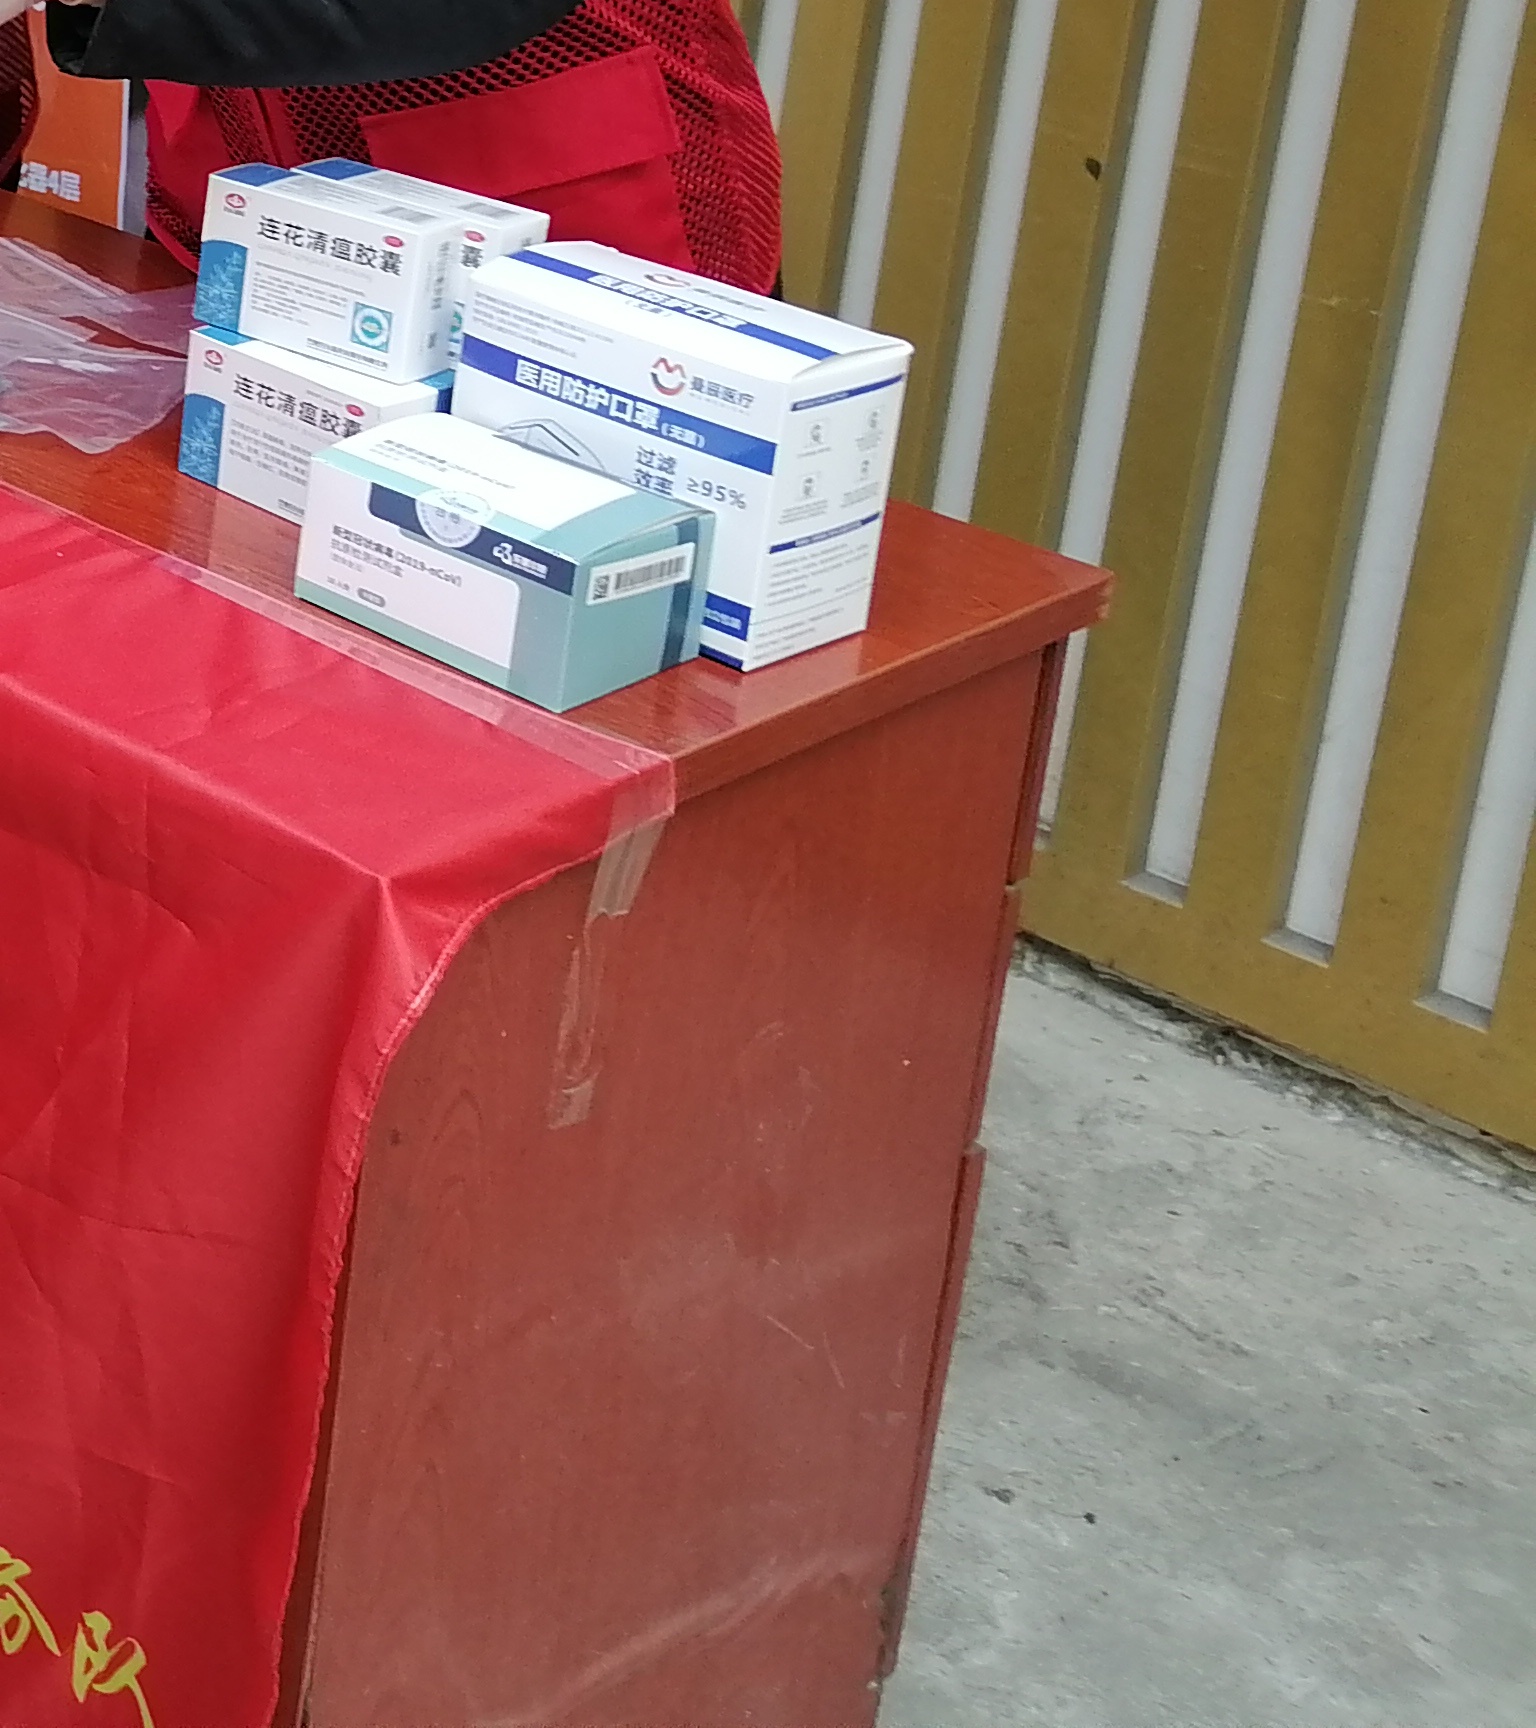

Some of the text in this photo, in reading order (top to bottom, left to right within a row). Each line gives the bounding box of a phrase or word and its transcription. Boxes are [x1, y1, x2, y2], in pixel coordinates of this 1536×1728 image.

[258, 215, 403, 277] 连花清瘟胶囊
[233, 373, 364, 439] 连花清瘟胶囊
[515, 359, 662, 431] 医用防护口罩
[632, 469, 675, 497] 效率
[636, 446, 678, 474] 过滤
